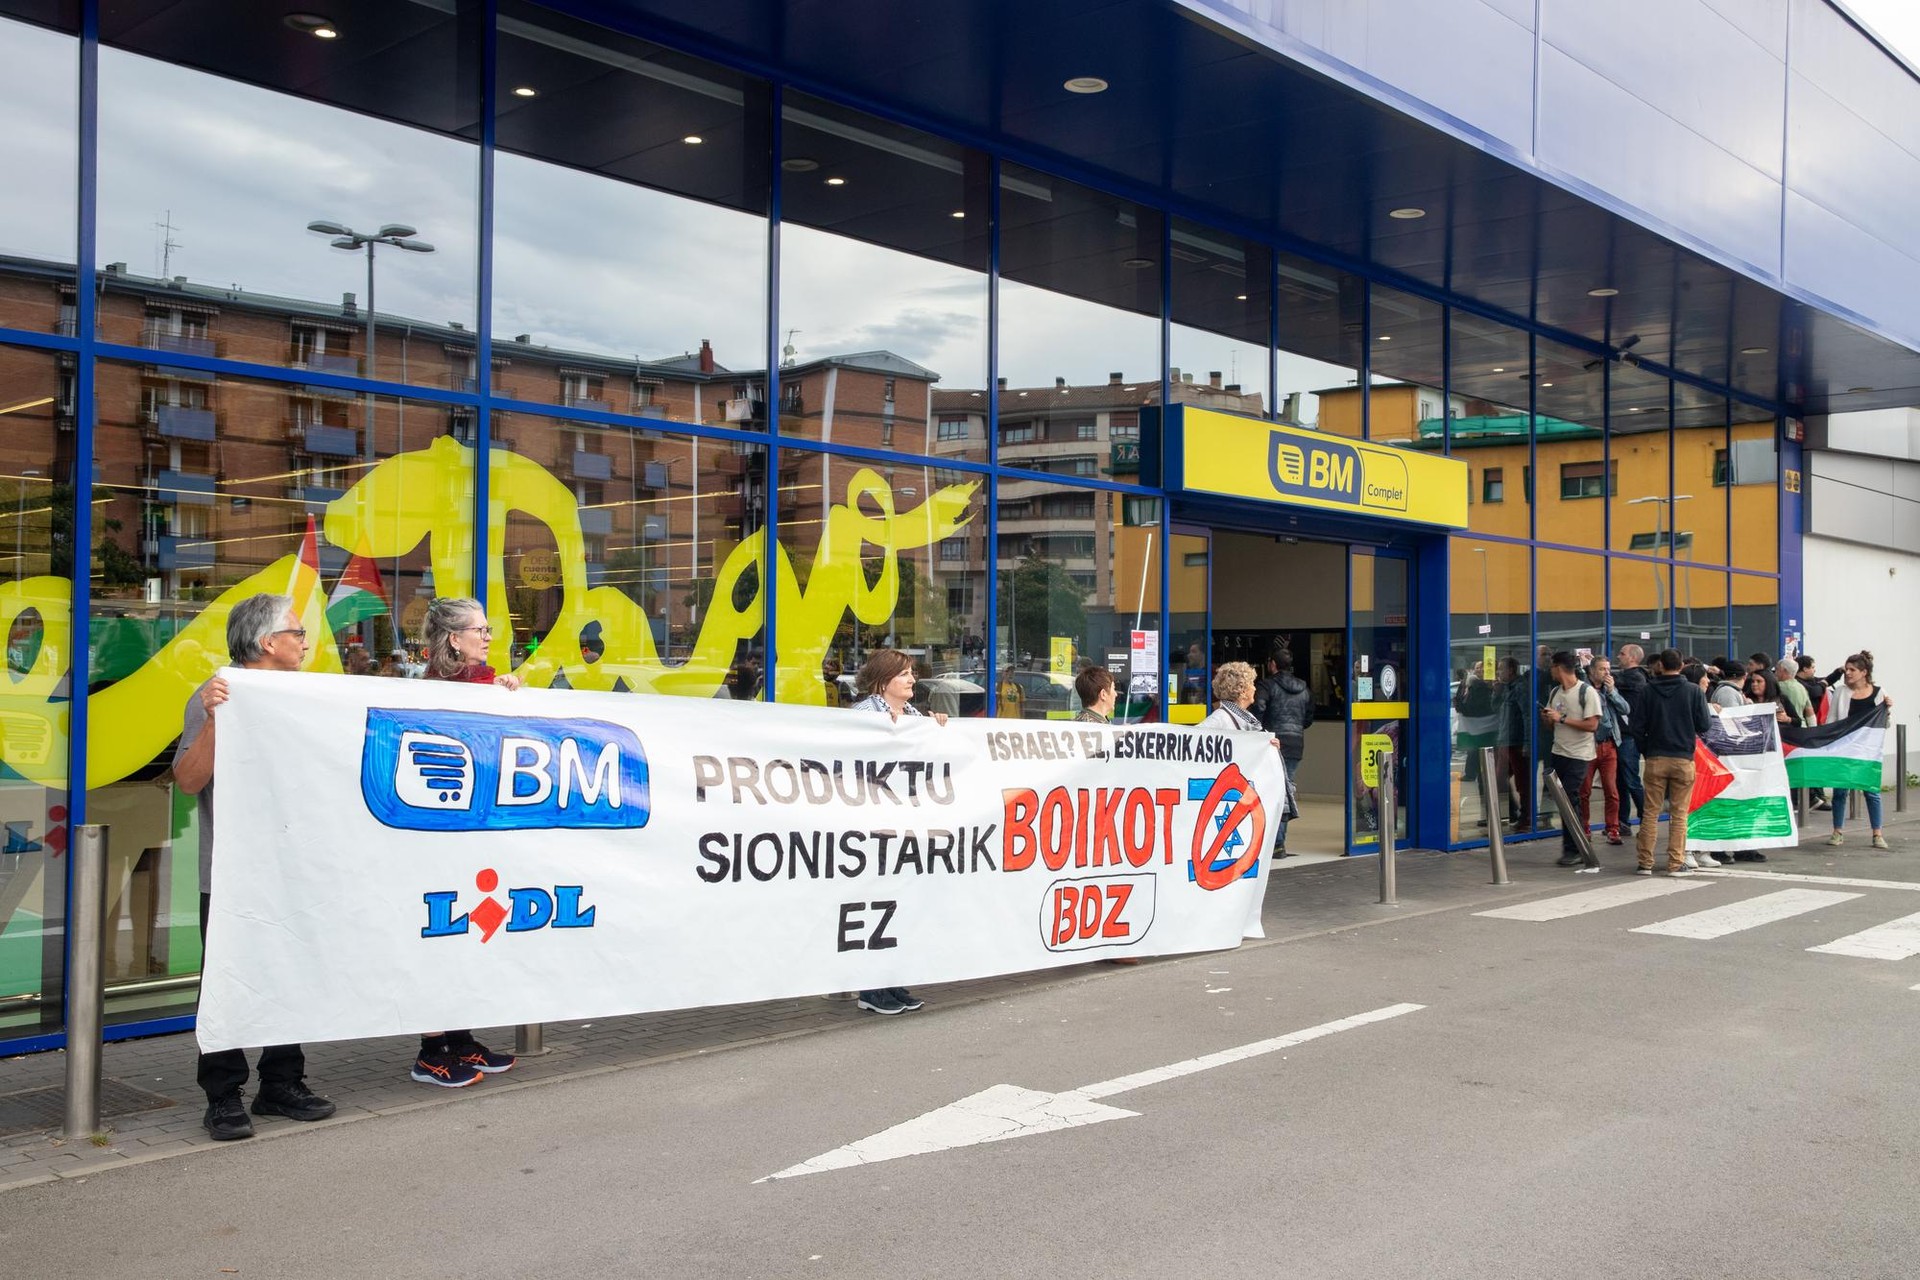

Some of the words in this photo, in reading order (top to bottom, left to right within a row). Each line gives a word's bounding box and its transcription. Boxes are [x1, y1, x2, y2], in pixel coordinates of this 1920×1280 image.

[1309, 449, 1354, 494] BM
[1367, 483, 1403, 502] Complet
[523, 565, 557, 574] cuenta
[495, 736, 623, 810] BM
[987, 731, 1075, 761] ISRAEL?
[1078, 731, 1111, 764] EZ,
[693, 754, 955, 807] PRODUKTU
[695, 823, 998, 883] SIONISTARIK
[1001, 787, 1181, 872] BOIKOT
[836, 900, 899, 952] EZ
[1050, 884, 1135, 946] BDZ
